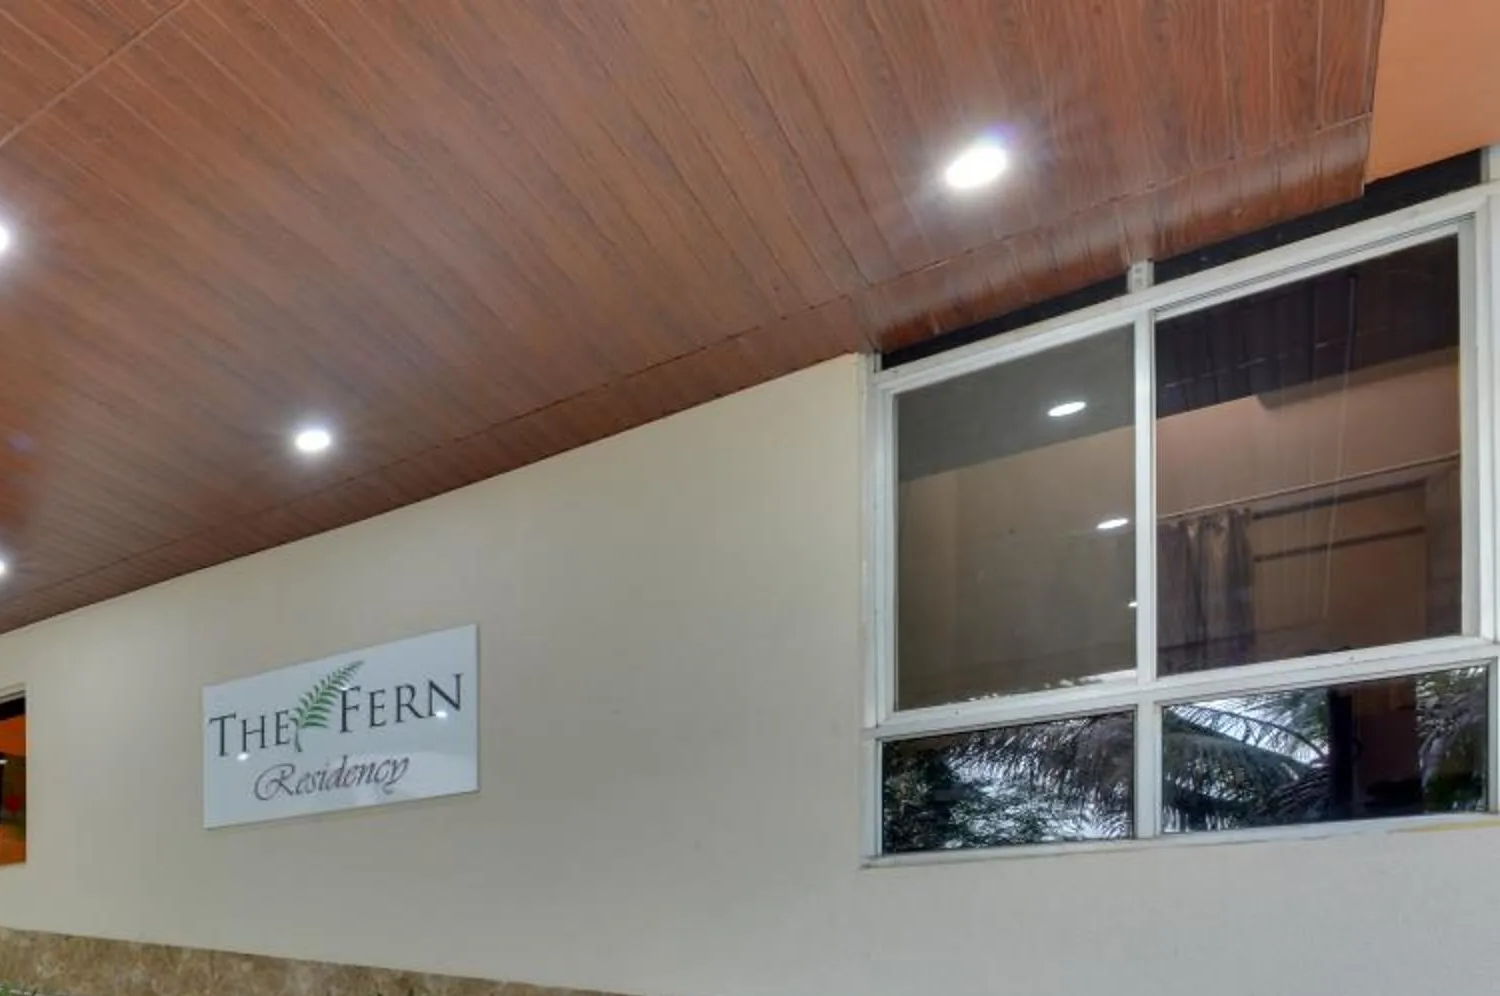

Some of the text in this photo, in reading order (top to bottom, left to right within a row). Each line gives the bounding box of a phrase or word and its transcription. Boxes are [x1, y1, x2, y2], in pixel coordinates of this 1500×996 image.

[209, 672, 464, 757] THE FERN
[254, 754, 410, 801] Residency
